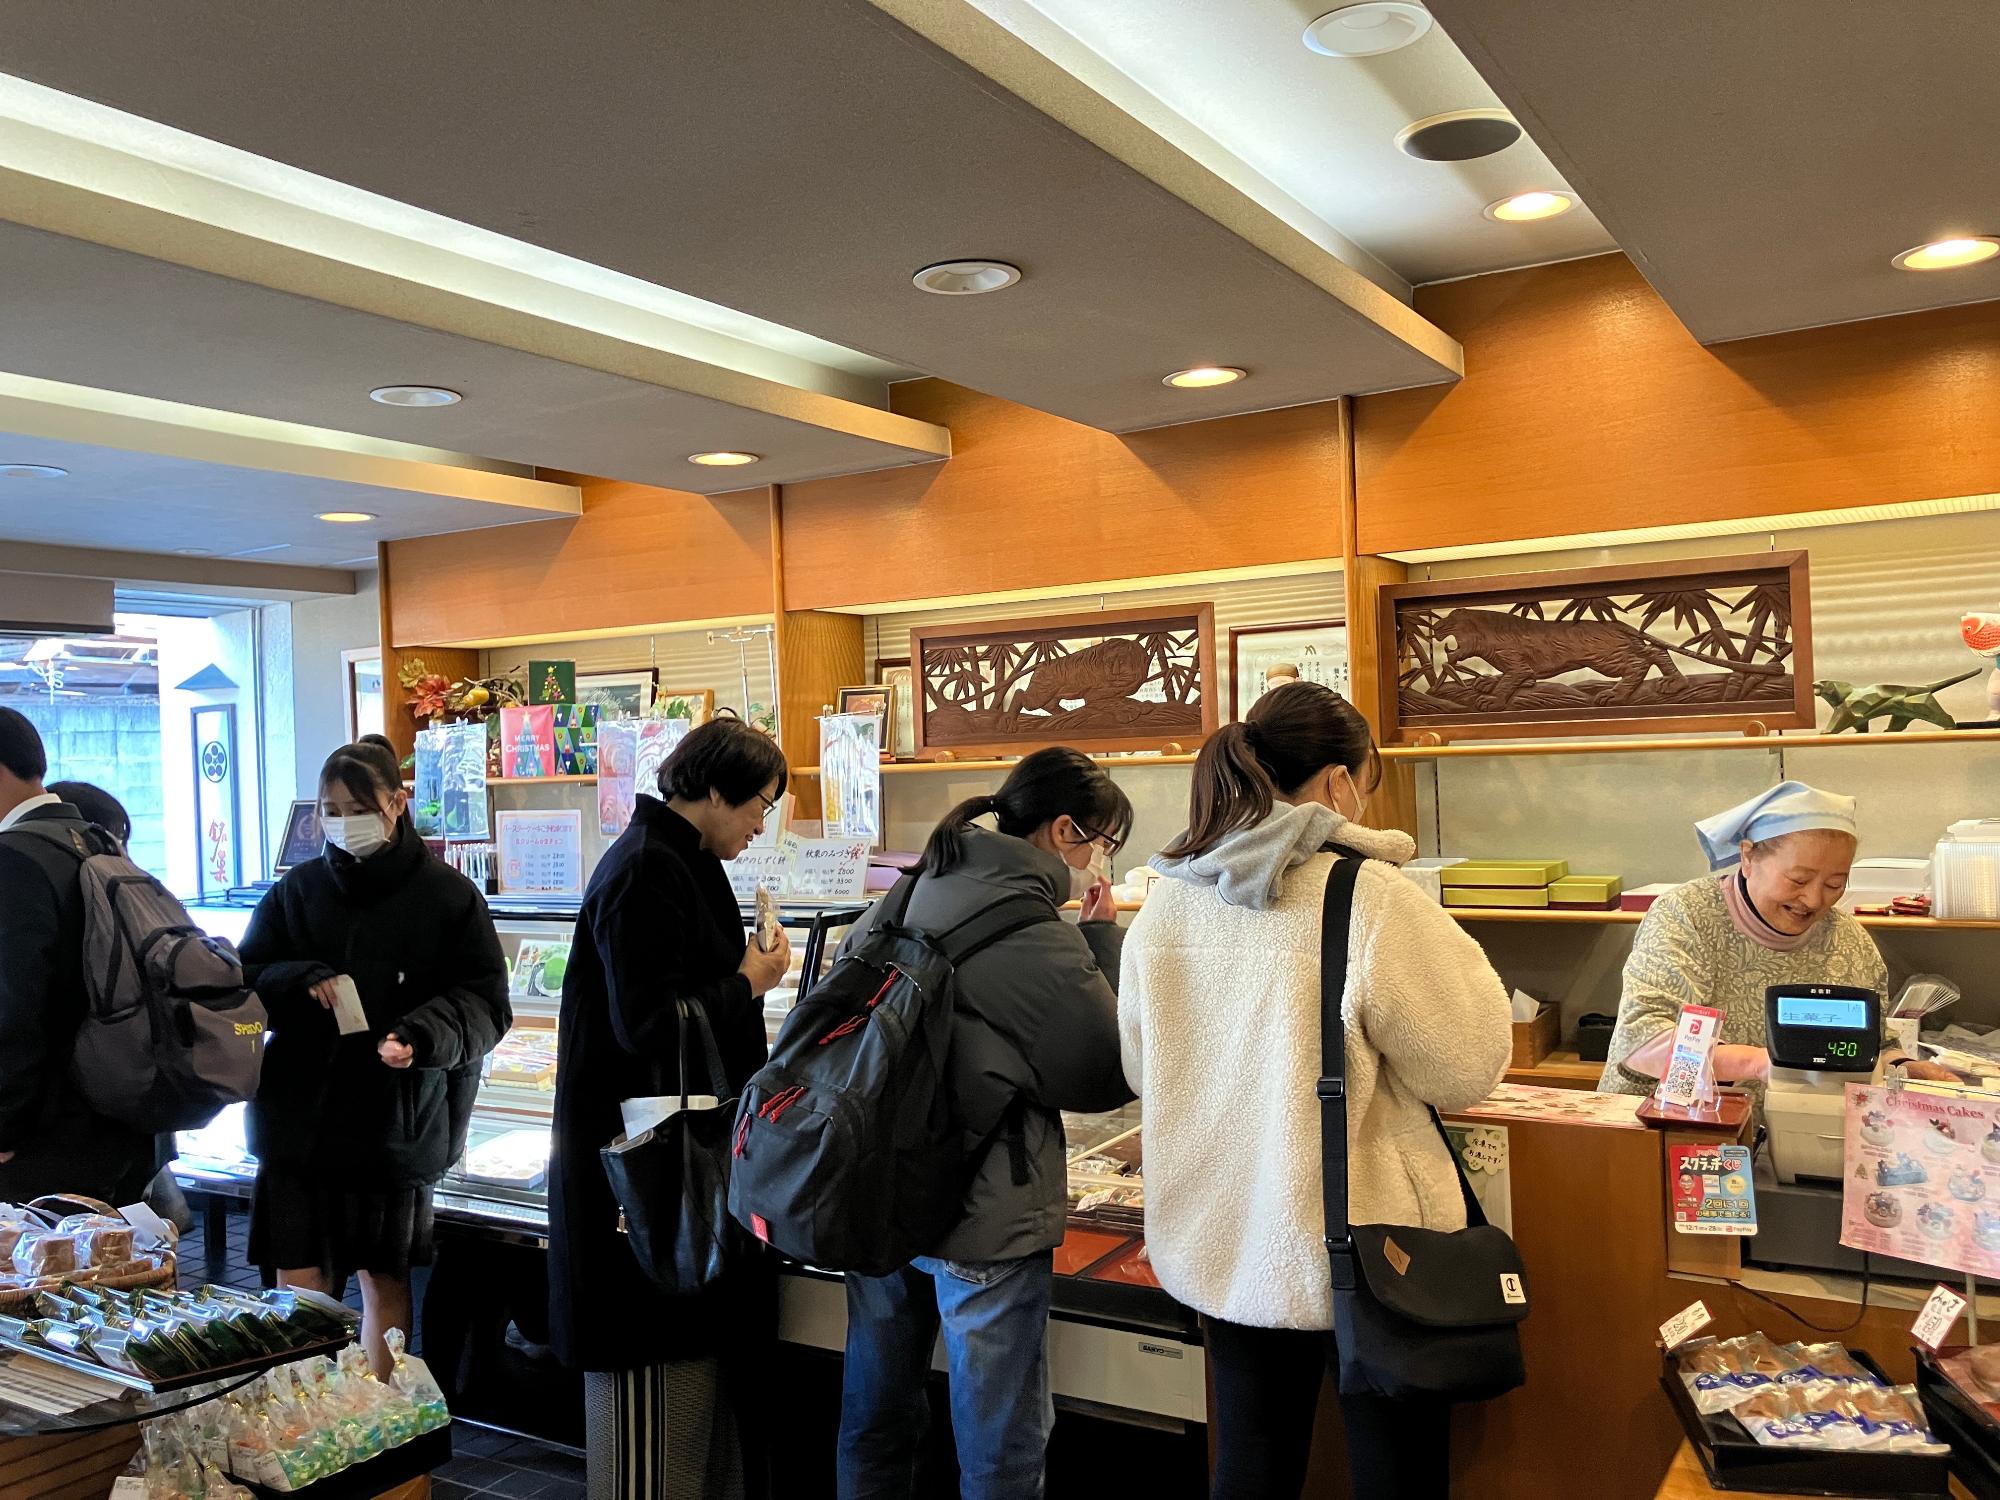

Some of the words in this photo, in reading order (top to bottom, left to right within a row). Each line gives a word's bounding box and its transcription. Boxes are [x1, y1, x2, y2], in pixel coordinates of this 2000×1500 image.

[514, 734, 540, 742] MERRY
[505, 743, 550, 753] CHRISTMAS
[834, 888, 850, 896] 6000
[1827, 1041, 1857, 1057] 420
[1886, 1094, 1946, 1115] Christmas
[1947, 1104, 1985, 1120] Cakes
[1679, 1156, 1742, 1171] スクラッチくじ
[1704, 1198, 1749, 1210] 2回に1回
